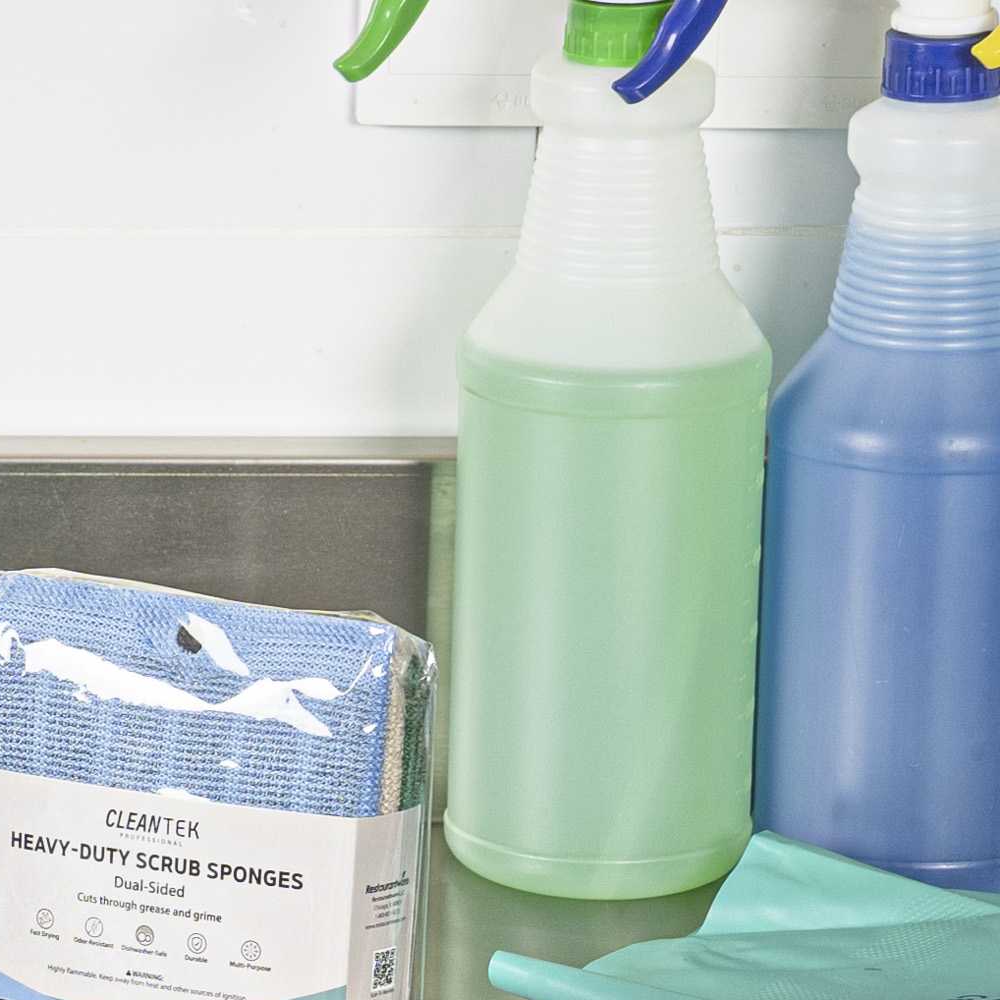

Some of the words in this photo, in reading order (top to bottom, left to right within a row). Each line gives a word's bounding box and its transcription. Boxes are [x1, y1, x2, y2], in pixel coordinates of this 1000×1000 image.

[105, 809, 200, 839] CLEANTEK
[11, 831, 130, 866] HEAVY-DUTY
[136, 852, 200, 876] SCRUB
[207, 862, 303, 890] SPONGES
[114, 875, 185, 897] Dual-Sided
[77, 892, 97, 904] Cuts
[99, 896, 137, 911] through
[139, 903, 171, 916] grease
[173, 908, 191, 918] and
[193, 911, 222, 922] grime
[229, 960, 271, 972] Multi-Purpose
